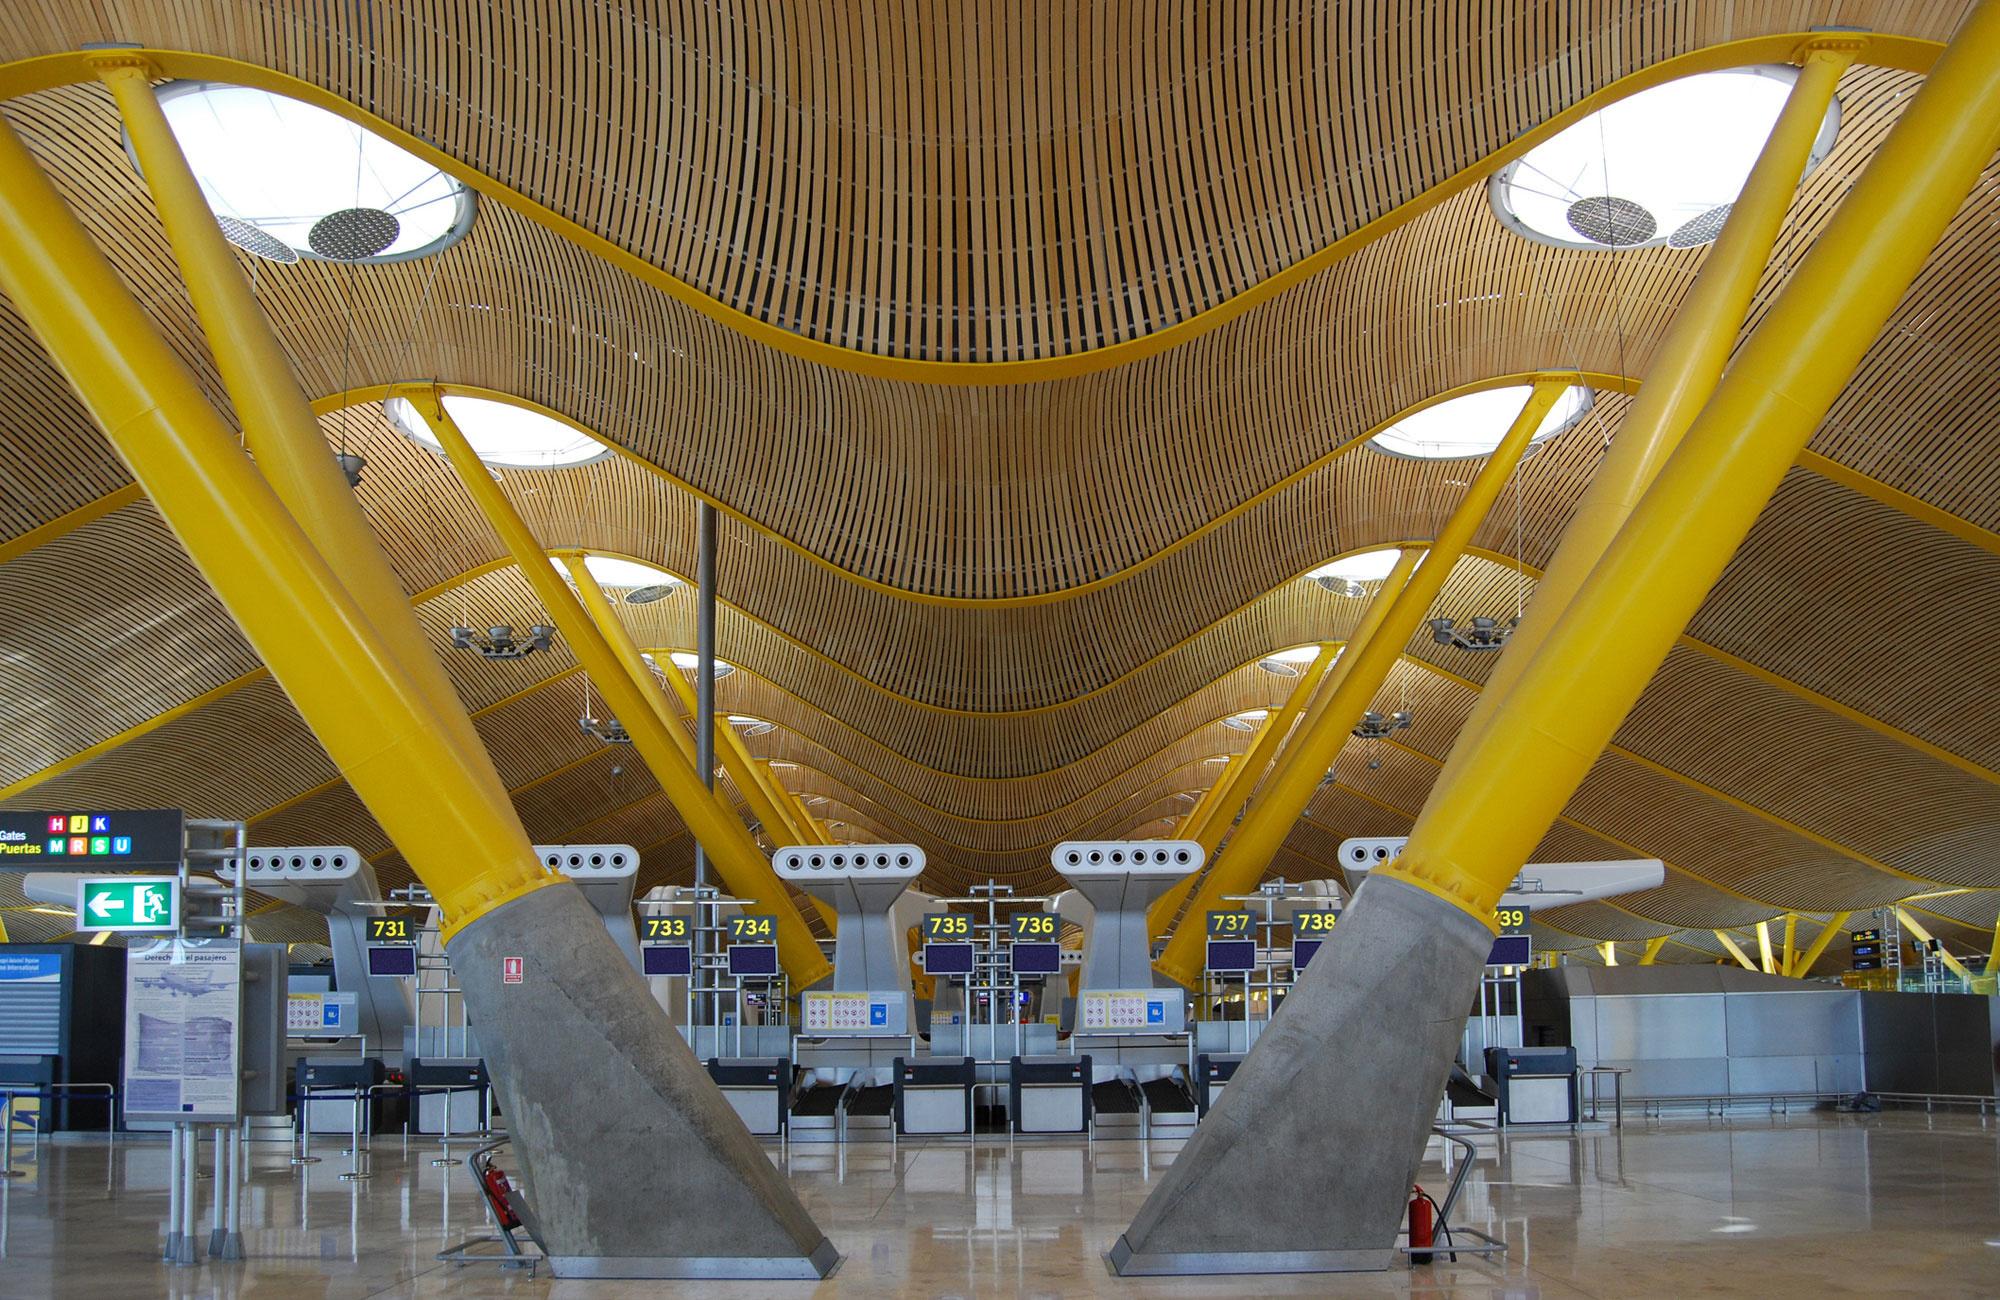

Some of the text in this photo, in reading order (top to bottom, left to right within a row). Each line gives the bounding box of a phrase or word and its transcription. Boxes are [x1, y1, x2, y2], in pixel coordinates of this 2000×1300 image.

[52, 818, 63, 830] H
[95, 818, 105, 830] K
[0, 831, 26, 841] Gates
[0, 843, 41, 854] Puertas
[50, 839, 127, 852] M R S U
[373, 921, 406, 936] 731
[647, 920, 685, 936] 733
[733, 919, 771, 935] 734
[930, 918, 968, 933] 735
[1016, 917, 1054, 933] 736
[1213, 915, 1249, 930] 737
[1298, 914, 1336, 930] 738
[194, 954, 227, 962] pasajero
